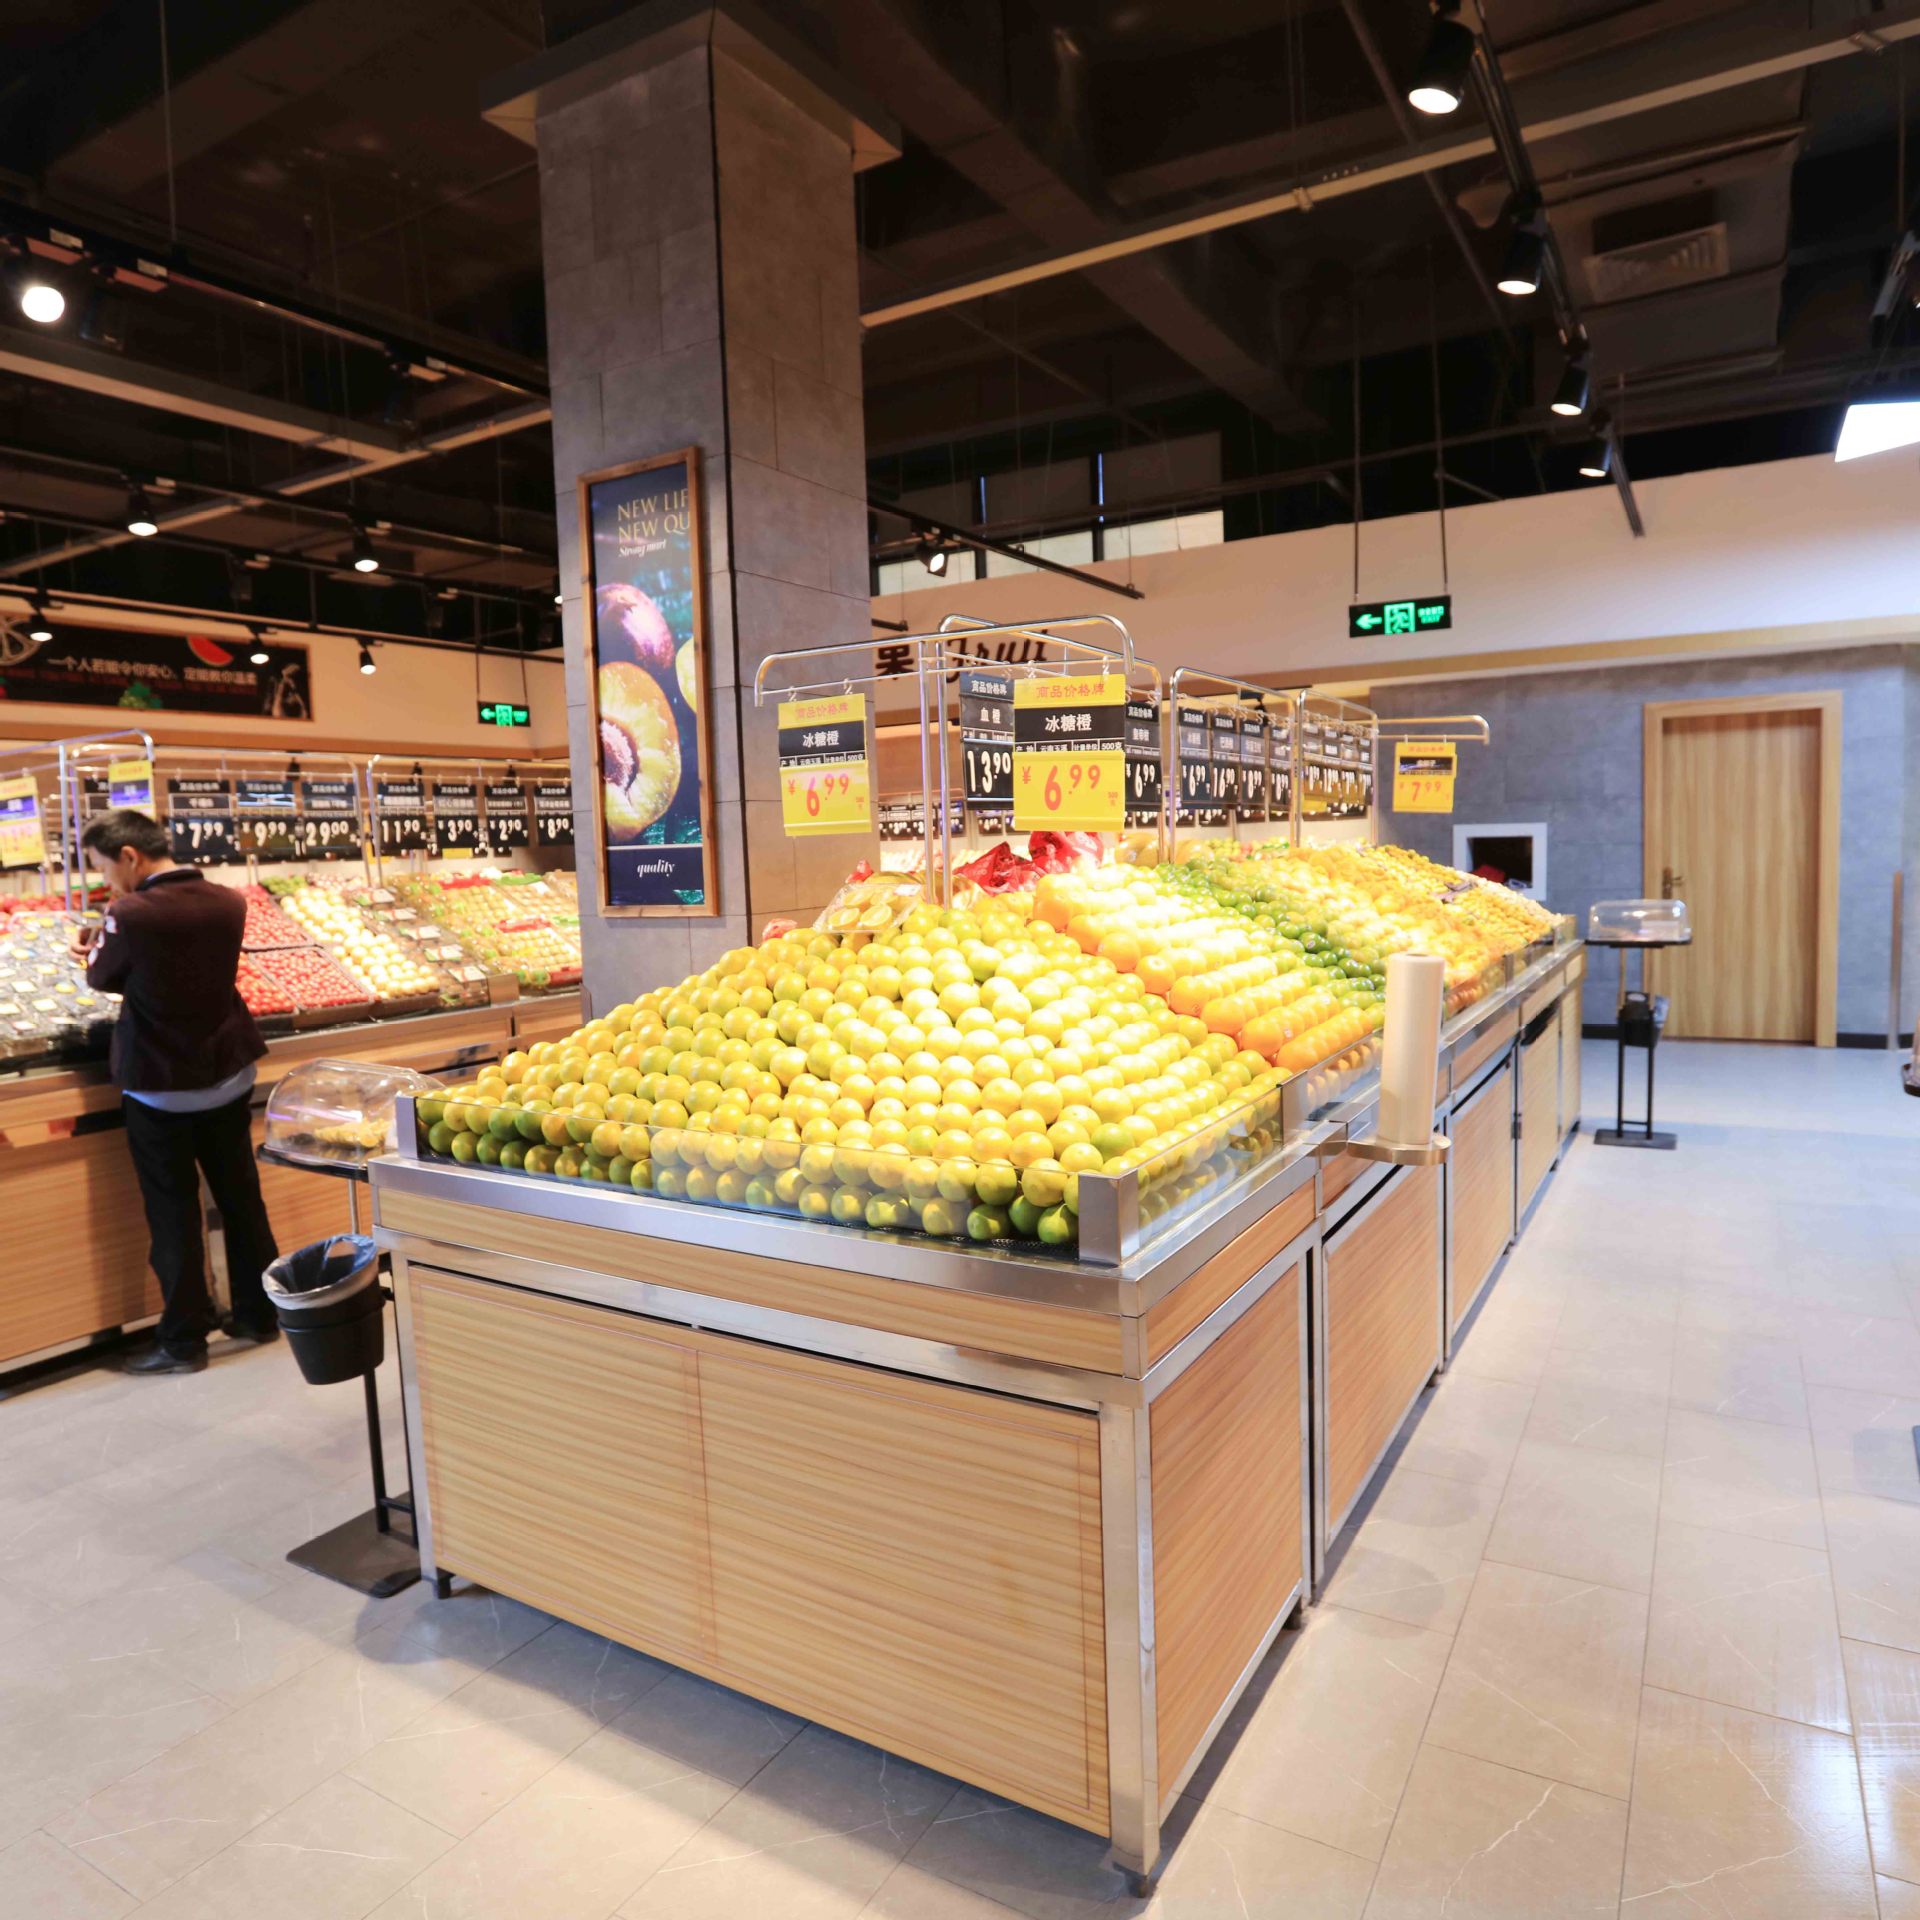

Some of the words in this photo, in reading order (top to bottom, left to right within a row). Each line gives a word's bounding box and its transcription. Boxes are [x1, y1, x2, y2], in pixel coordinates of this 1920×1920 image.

[618, 495, 657, 522] NEW
[618, 518, 658, 541] NEW
[663, 512, 689, 535] QU
[1036, 683, 1105, 698] 商品价格牌
[1045, 714, 1092, 732] 冰糖橙
[803, 731, 839, 748] 冰糖橙
[967, 750, 1011, 793] 13.90
[637, 859, 675, 878] quality
